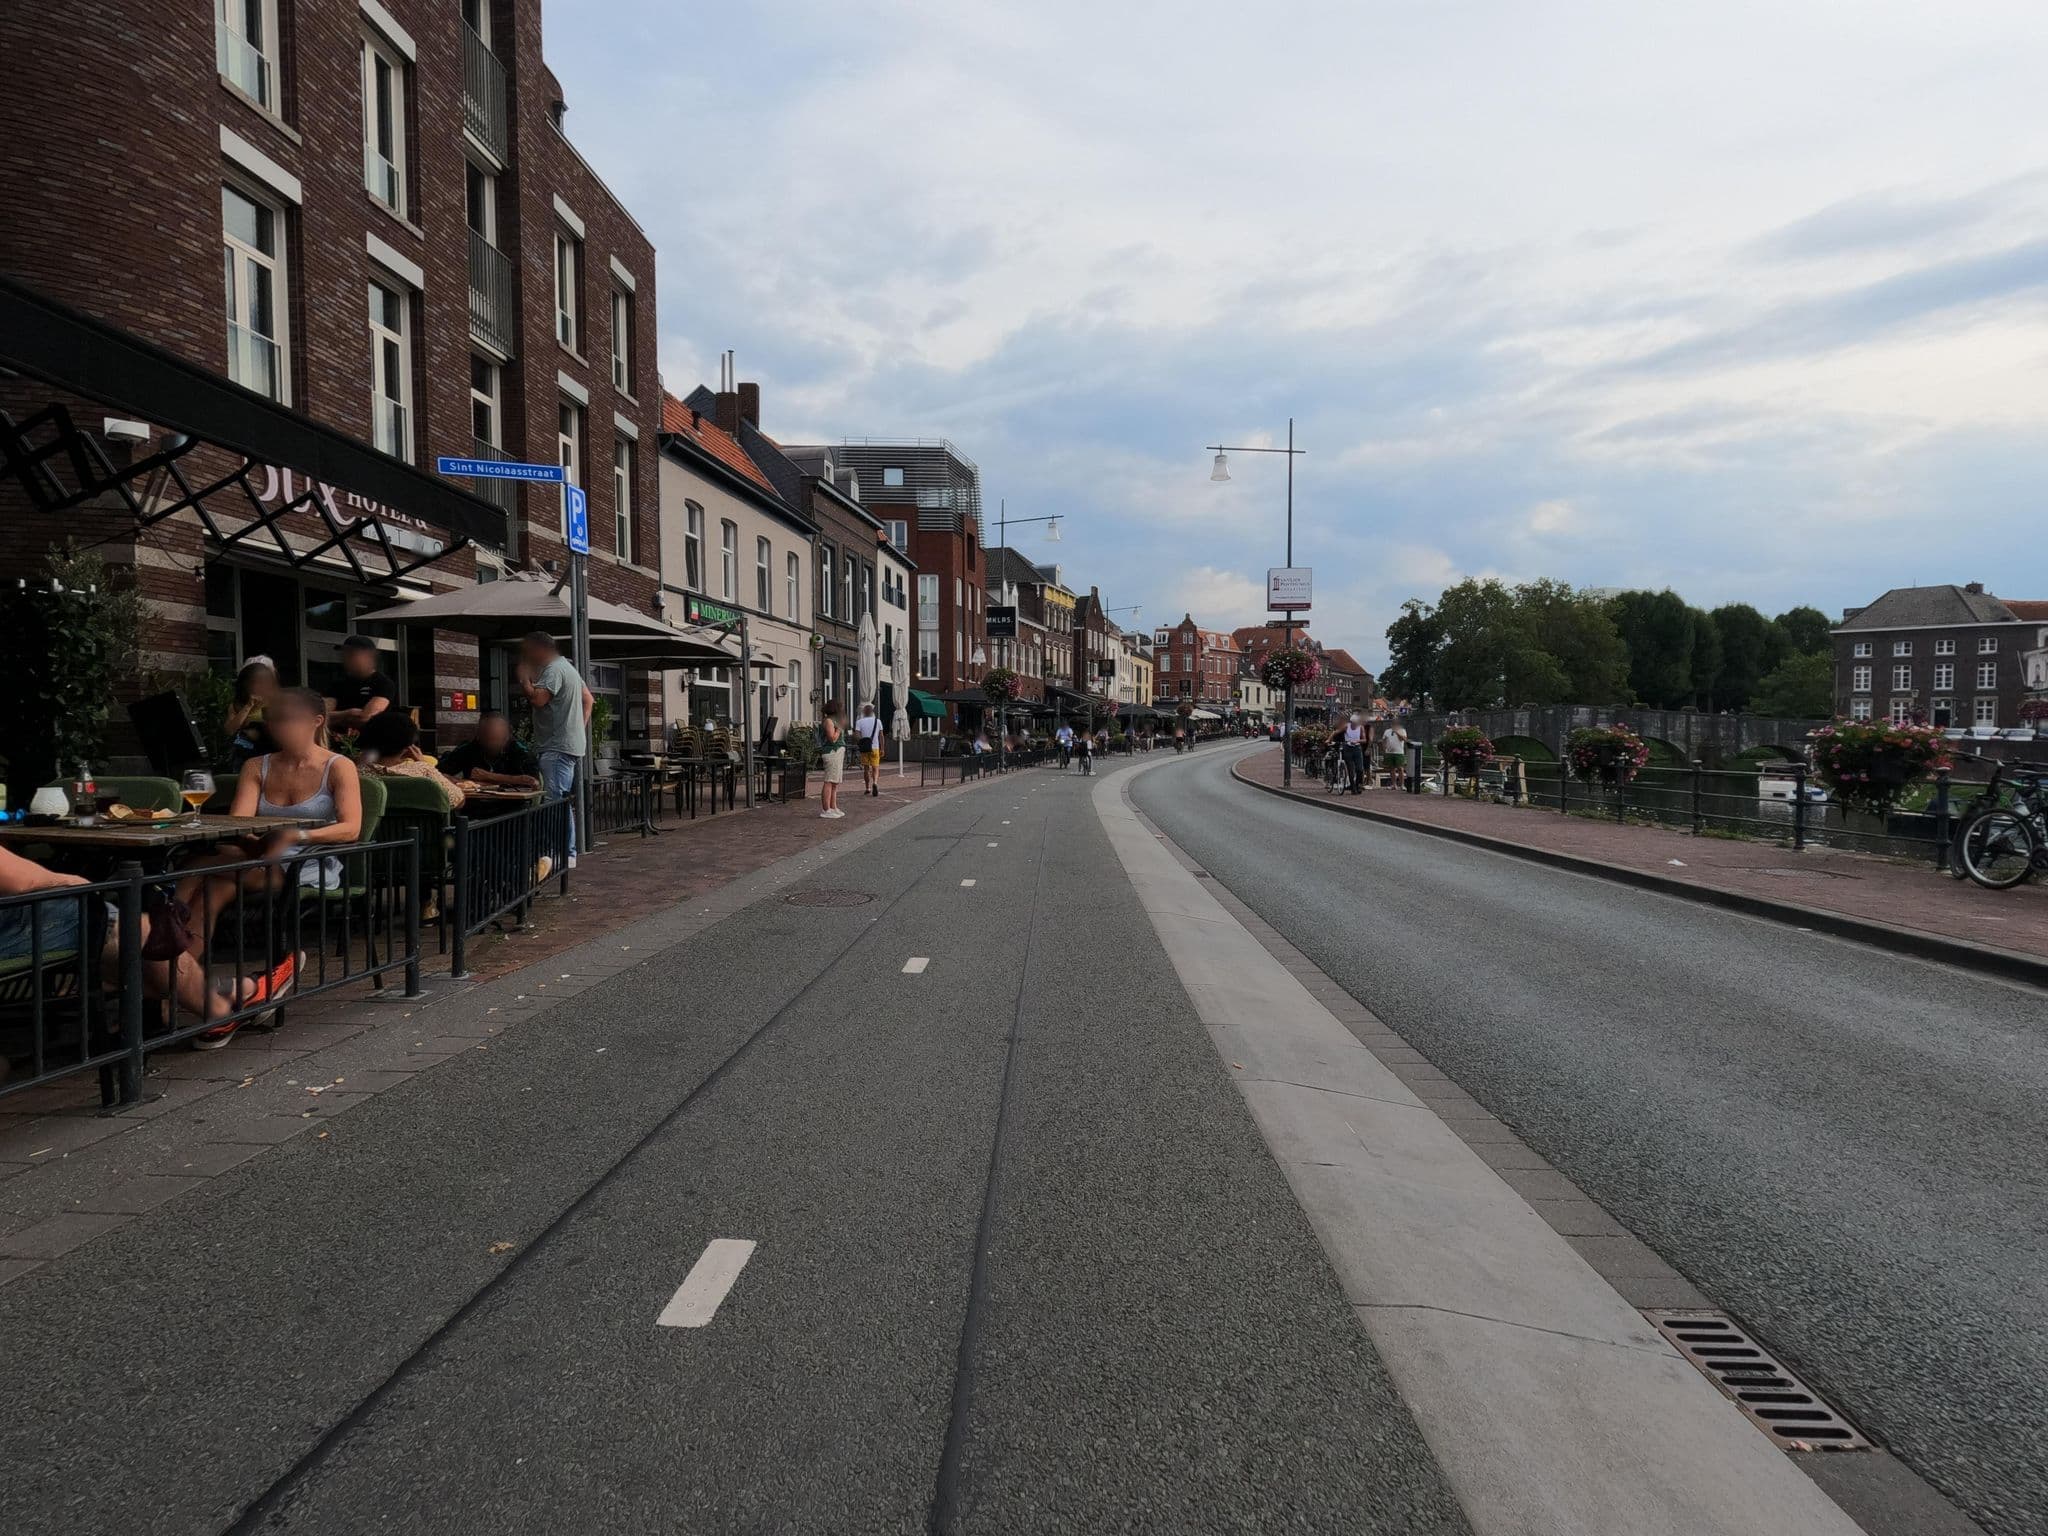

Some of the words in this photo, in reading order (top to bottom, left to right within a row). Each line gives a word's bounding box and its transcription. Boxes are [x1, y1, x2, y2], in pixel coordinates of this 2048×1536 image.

[449, 461, 473, 473] Sint
[476, 463, 555, 478] Nicolaasstraat
[572, 491, 583, 524] P
